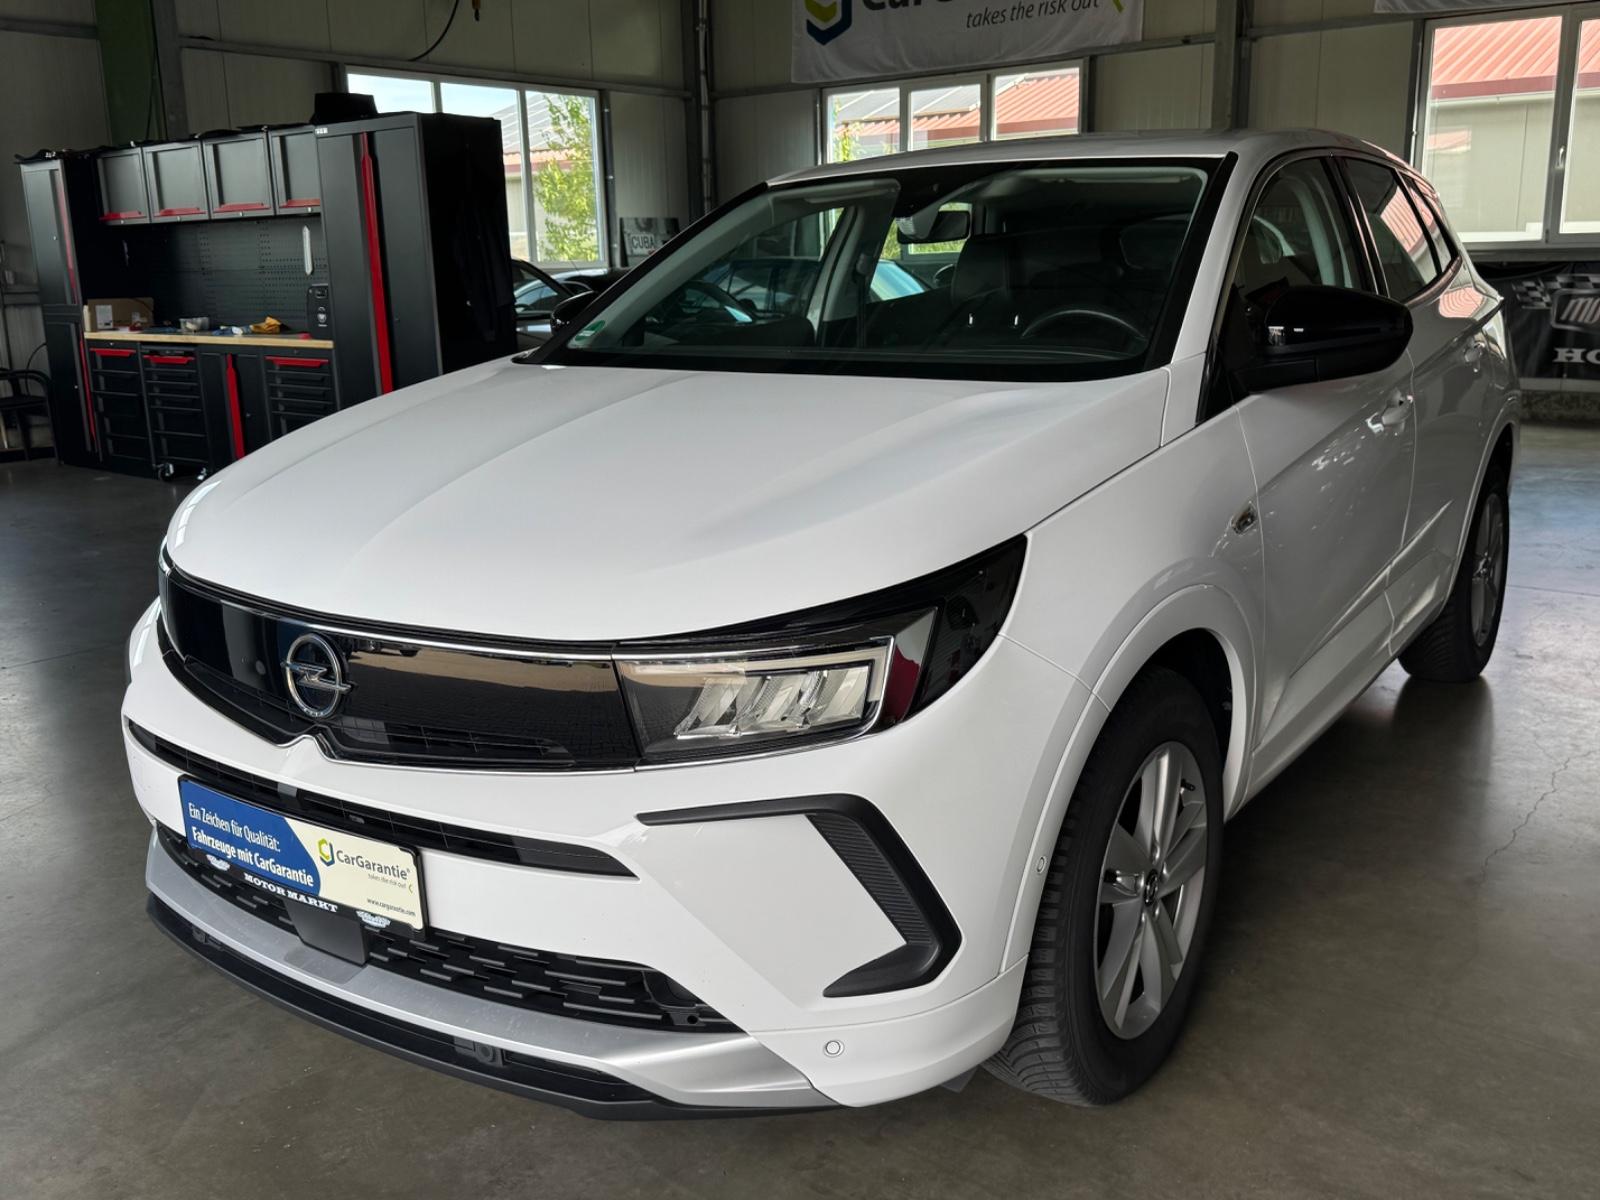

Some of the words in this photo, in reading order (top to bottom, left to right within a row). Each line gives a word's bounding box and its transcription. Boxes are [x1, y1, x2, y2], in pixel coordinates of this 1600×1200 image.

[966, 7, 1006, 28] takes
[1010, 1, 1034, 21] the
[1038, 0, 1066, 16] risk
[631, 235, 655, 249] CUBA
[188, 802, 201, 820] Ein
[201, 807, 230, 833] Zeichen
[231, 819, 243, 838] für
[243, 825, 281, 852] Qualität:
[192, 826, 236, 859] Fahrzeuge
[237, 847, 254, 865] mit
[254, 852, 314, 887] CarGarantie
[243, 872, 287, 897] MOTOR
[287, 889, 338, 912] MARKT
